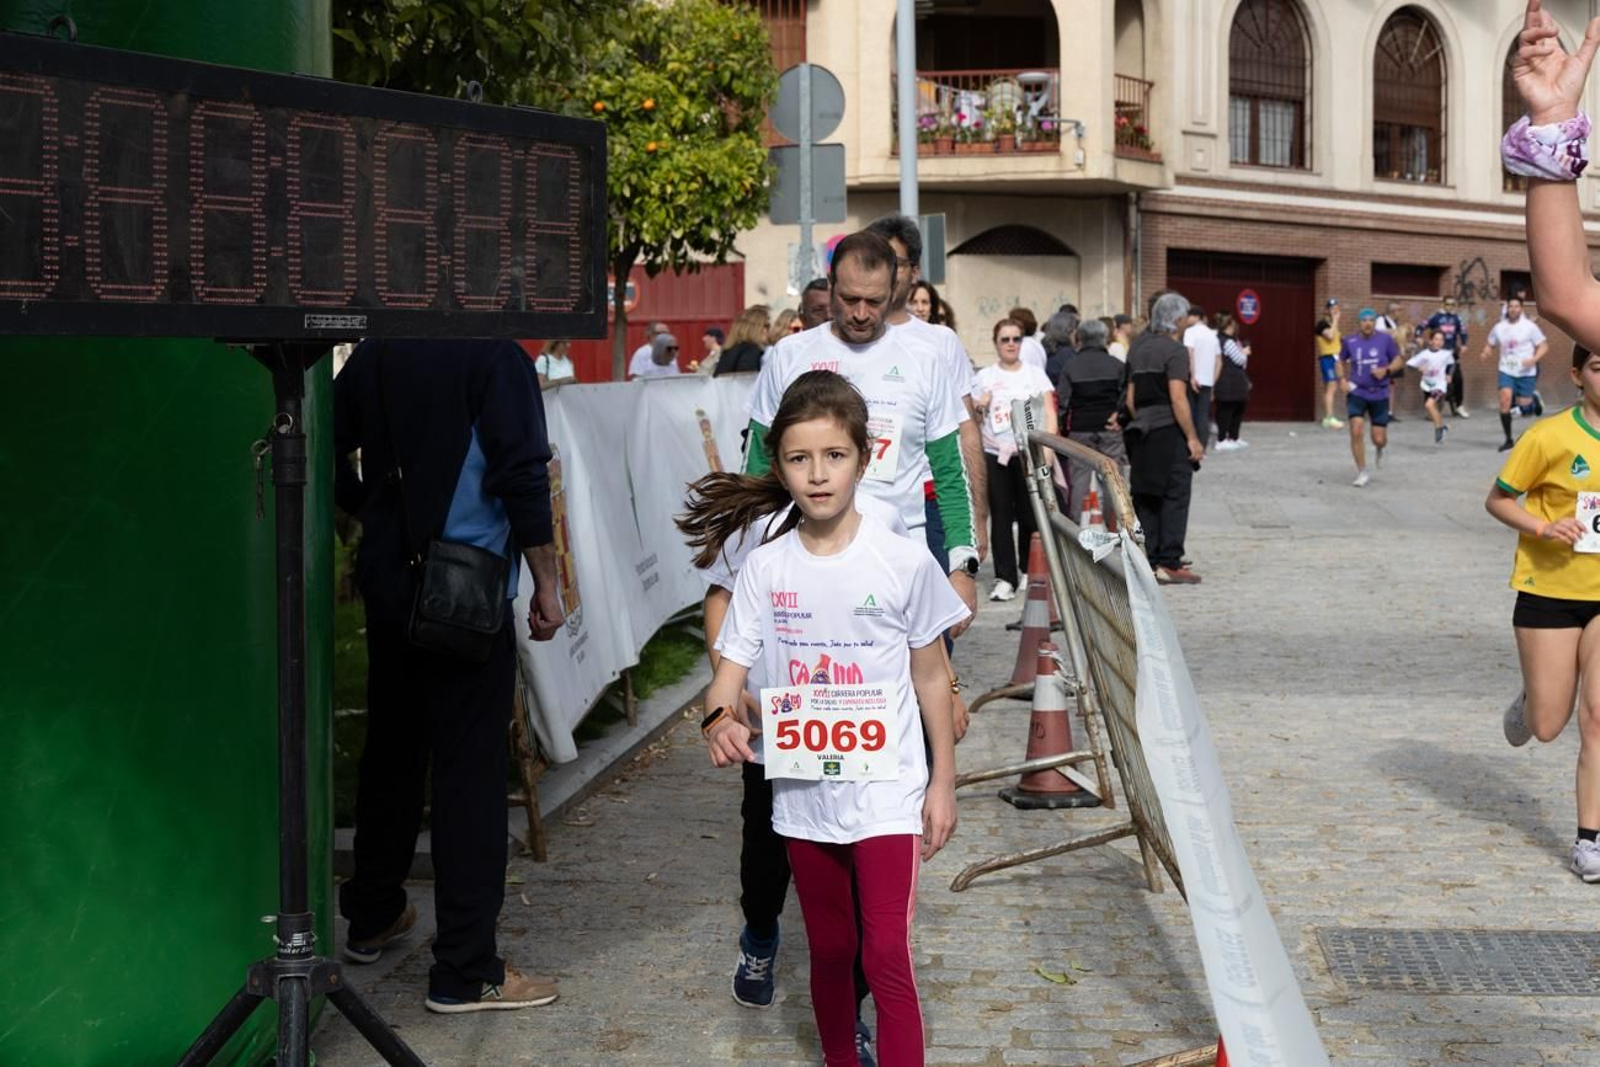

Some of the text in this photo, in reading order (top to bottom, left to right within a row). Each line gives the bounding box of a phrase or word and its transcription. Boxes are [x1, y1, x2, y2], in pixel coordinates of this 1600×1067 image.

[831, 688, 856, 698] CARRERA
[856, 687, 883, 697] POPULAR
[776, 719, 886, 752] 5069
